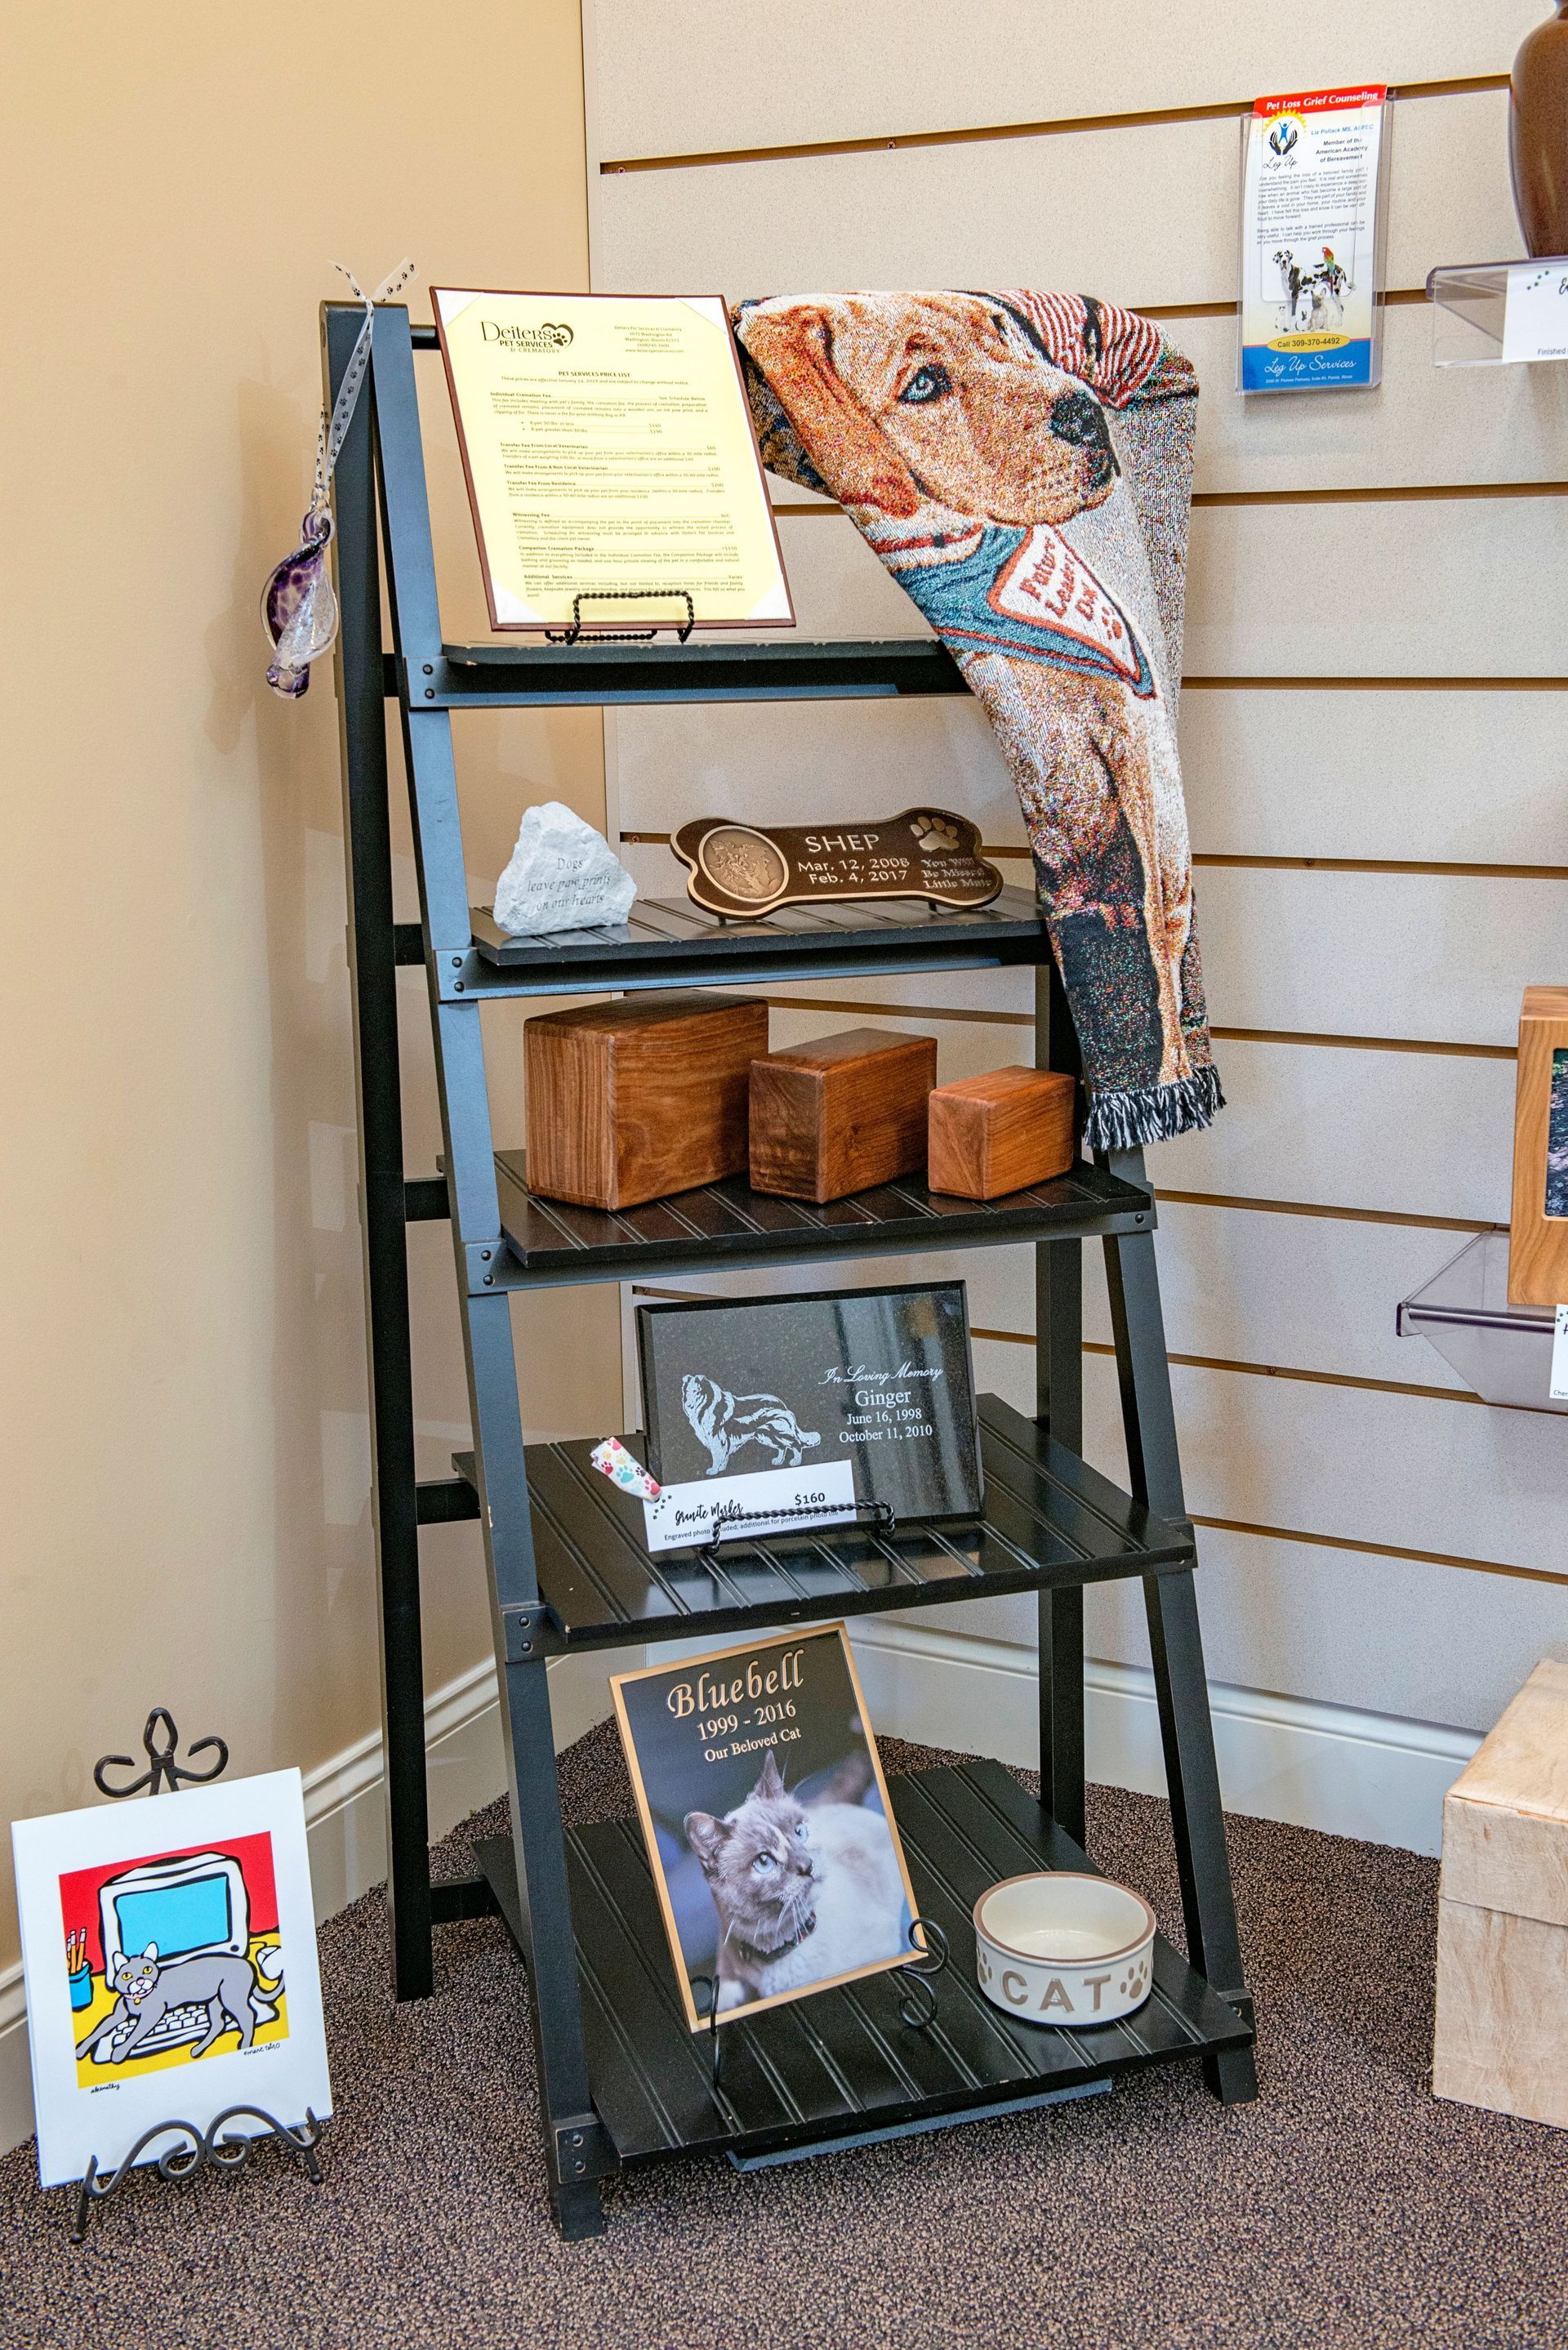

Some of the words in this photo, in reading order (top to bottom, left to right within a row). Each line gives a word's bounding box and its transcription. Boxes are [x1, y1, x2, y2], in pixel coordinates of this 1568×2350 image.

[1266, 101, 1280, 110] Pet
[1282, 100, 1301, 109] Loss
[1303, 95, 1328, 106] Grief
[1329, 91, 1379, 104] Counseling
[1263, 157, 1282, 171] Leg
[1285, 154, 1298, 170] Up
[1326, 154, 1363, 162] Bereavement
[1292, 337, 1340, 347] 309-370-4492
[1537, 347, 1566, 355] Finished
[1264, 357, 1285, 377] Leg
[1289, 355, 1307, 376] Up
[1309, 355, 1356, 371] Services
[804, 834, 880, 854] SHEP
[556, 857, 585, 872] Dogs
[797, 860, 835, 873] Mar.
[839, 858, 865, 872] 12,
[869, 857, 911, 869] 2008
[920, 858, 947, 868] You
[808, 872, 844, 885] Feb.
[849, 872, 864, 885] 4,
[868, 870, 907, 882] 2017
[921, 869, 939, 879] Be
[941, 867, 985, 878] Missed
[528, 880, 555, 892] leave
[557, 878, 580, 892] paw
[579, 873, 612, 890] prints
[923, 879, 958, 890] Little
[536, 901, 549, 911] on
[551, 898, 569, 908] our
[572, 894, 604, 906] hearts
[817, 1367, 843, 1385] In
[843, 1364, 891, 1386] Loving
[890, 1361, 943, 1382] Memory
[854, 1389, 911, 1408] Ginger
[846, 1413, 872, 1425] June
[875, 1411, 893, 1424] 16,
[896, 1407, 922, 1421] 1998
[839, 1429, 884, 1443] October
[887, 1427, 902, 1441] 11,
[905, 1425, 933, 1438] 2010
[795, 1492, 826, 1506] $160
[675, 1504, 709, 1526] Granite
[710, 1499, 744, 1517] Marker
[664, 1532, 692, 1541] Engraved
[693, 1528, 710, 1537] photo
[740, 1520, 770, 1529] additional
[781, 1514, 808, 1524] porcelain
[809, 1512, 827, 1520] photo
[666, 1648, 804, 1719] Bluebell
[697, 1715, 738, 1741] 1999
[755, 1699, 796, 1726] 2016
[704, 1748, 728, 1762] Our
[731, 1732, 778, 1755] Beloved
[780, 1727, 802, 1741] Cat
[1001, 1969, 1111, 2012] CAT
